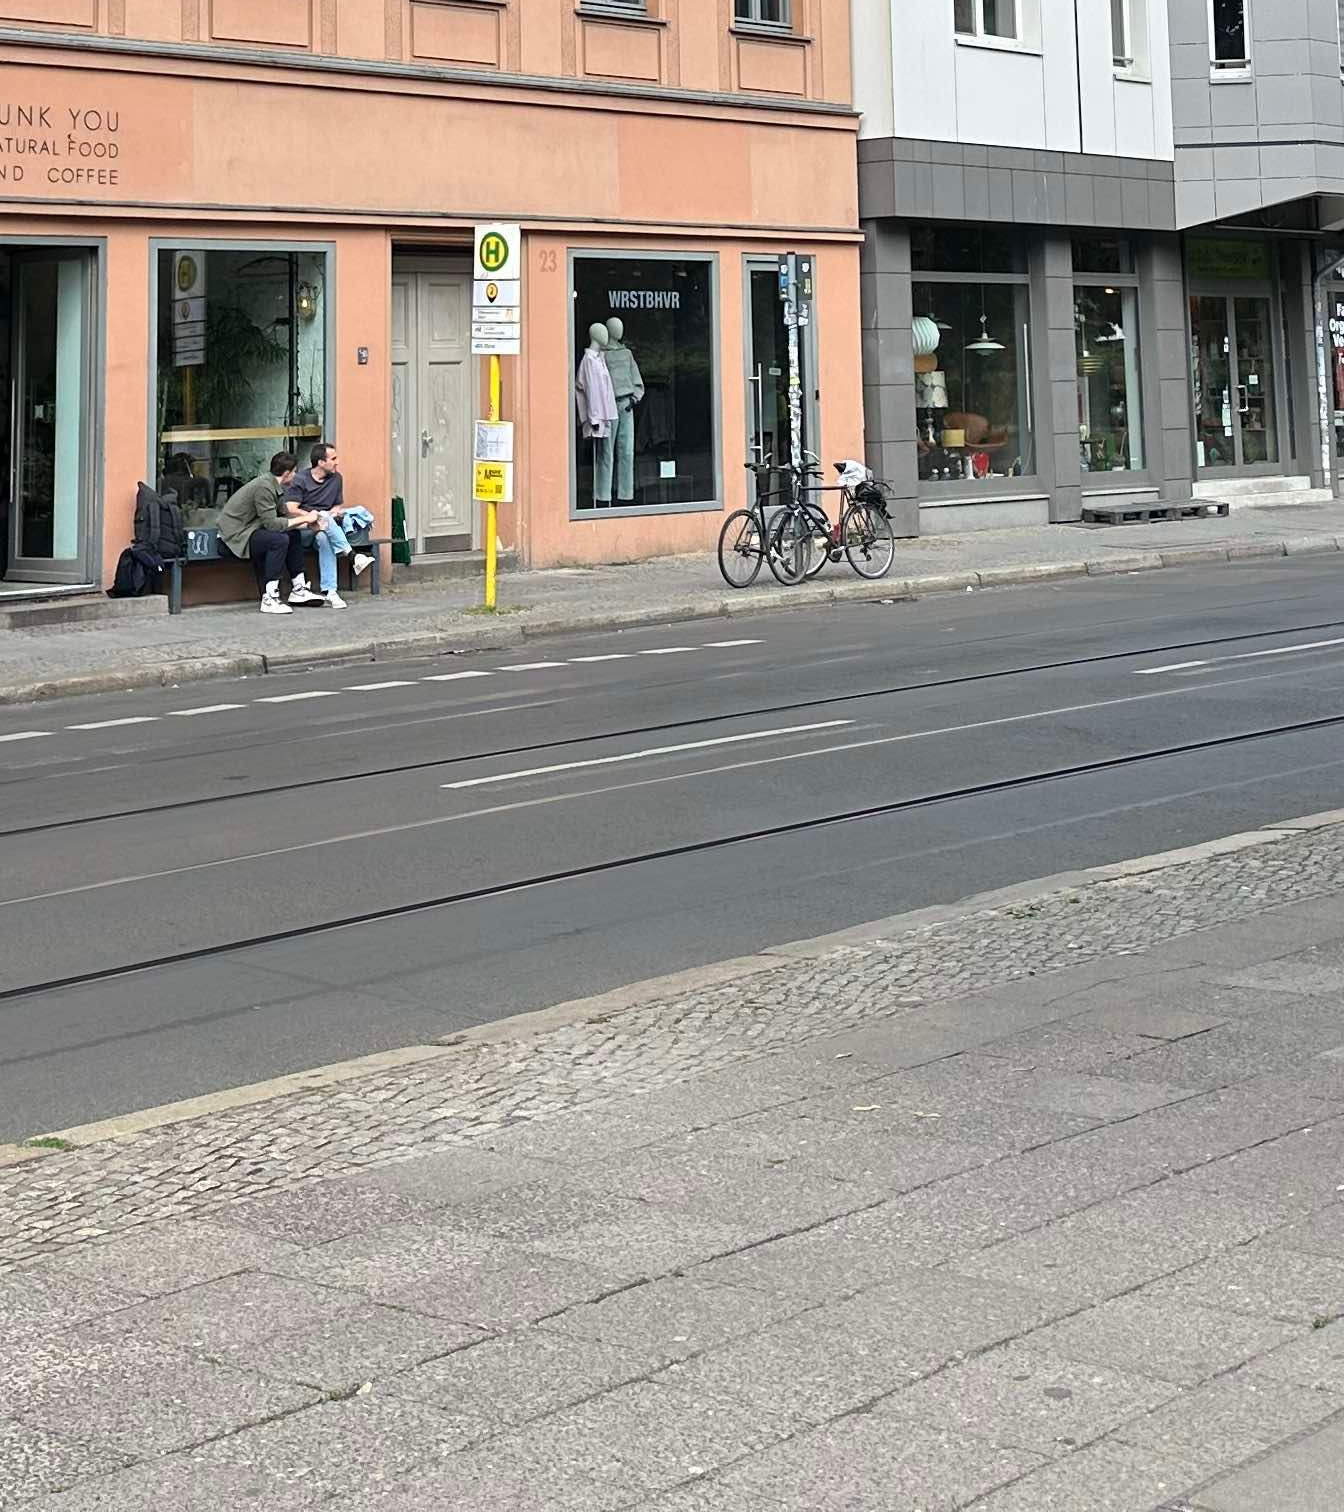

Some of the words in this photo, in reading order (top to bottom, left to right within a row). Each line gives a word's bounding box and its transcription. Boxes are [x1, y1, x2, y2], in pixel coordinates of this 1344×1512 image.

[68, 108, 119, 132] YOU
[68, 140, 119, 159] FOOD
[47, 167, 118, 185] COFFEE
[486, 240, 500, 263] H
[539, 250, 557, 273] 23
[608, 290, 680, 309] WRSTBHVR
